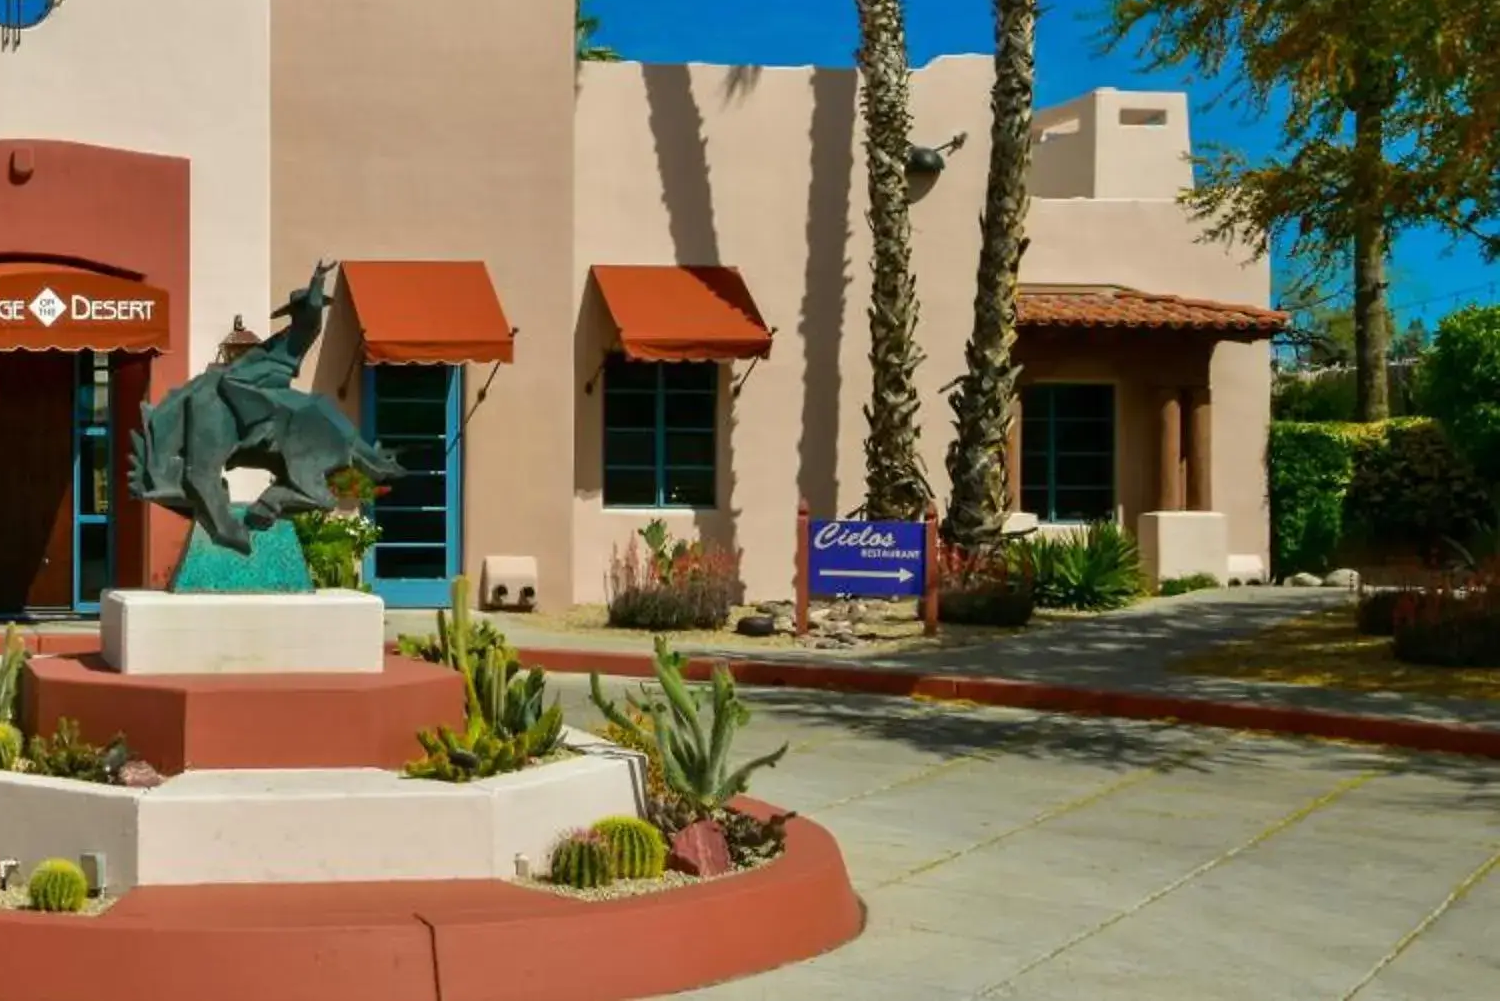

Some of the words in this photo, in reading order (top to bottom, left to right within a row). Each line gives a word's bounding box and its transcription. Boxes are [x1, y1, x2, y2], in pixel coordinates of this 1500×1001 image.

[71, 295, 156, 320] DESERT
[814, 522, 896, 550] Cielos
[861, 550, 921, 560] RESTAURANT
